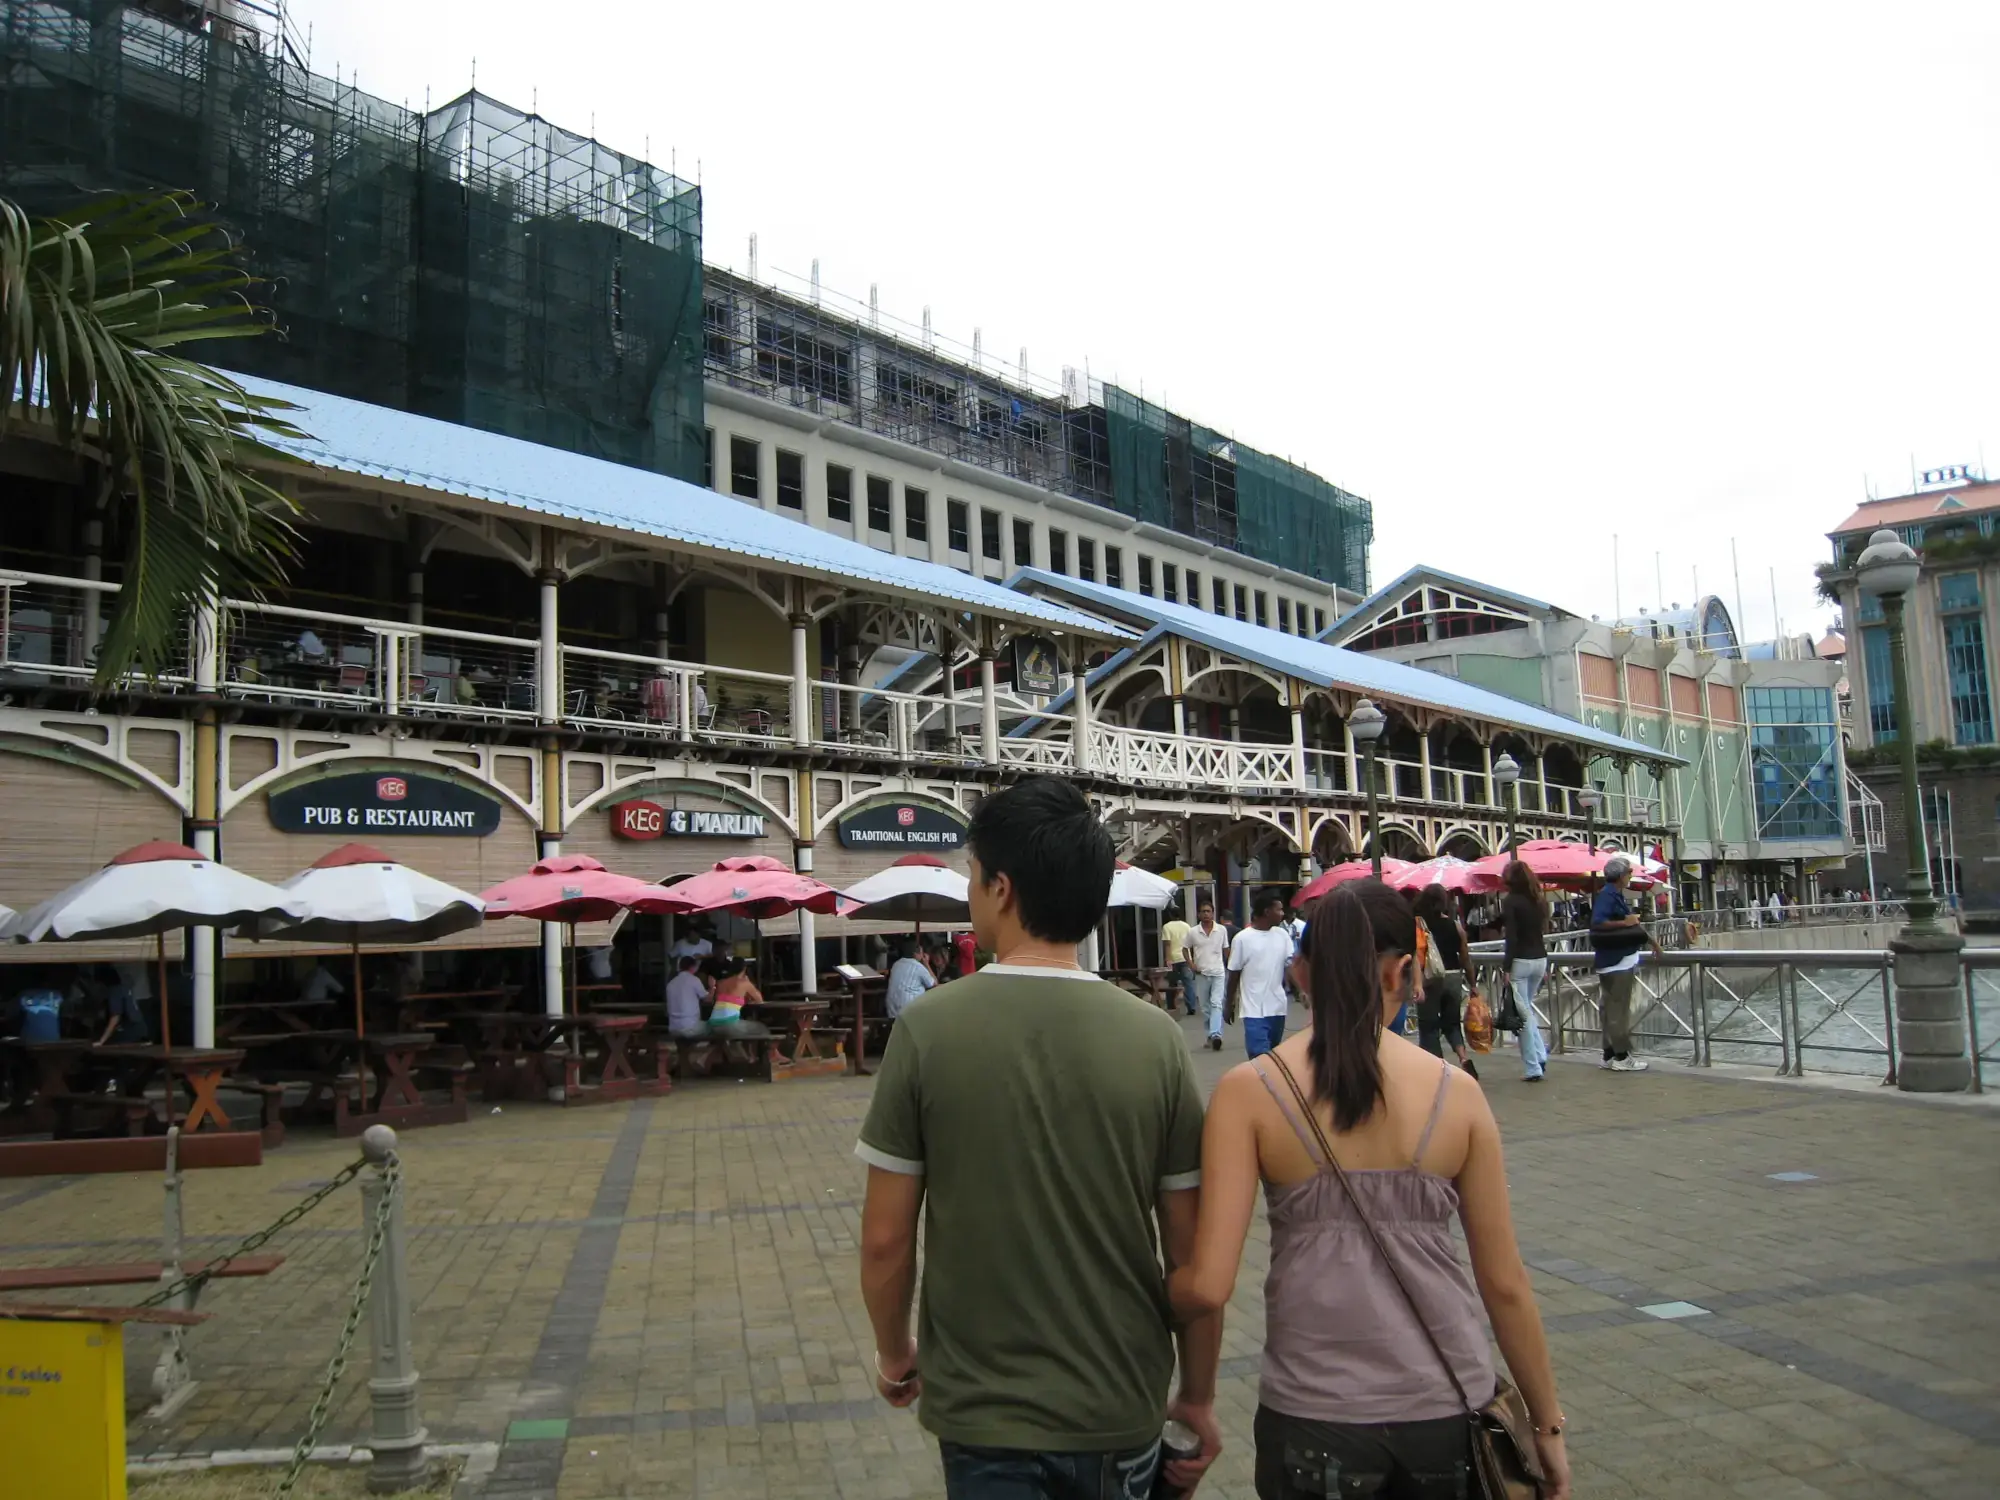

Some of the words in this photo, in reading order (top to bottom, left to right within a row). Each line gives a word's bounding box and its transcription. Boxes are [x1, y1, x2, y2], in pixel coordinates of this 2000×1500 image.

[379, 780, 406, 797] KEG
[303, 806, 342, 825] PUB
[347, 807, 359, 825] &
[365, 808, 475, 828] RESTAURANT
[623, 808, 661, 832] KEG
[669, 810, 687, 833] &
[690, 812, 764, 836] MARLIN
[898, 811, 915, 822] KEG
[850, 829, 905, 842] TRADITIONAL
[907, 831, 940, 843] ENGLISH
[942, 832, 958, 844] PUB
